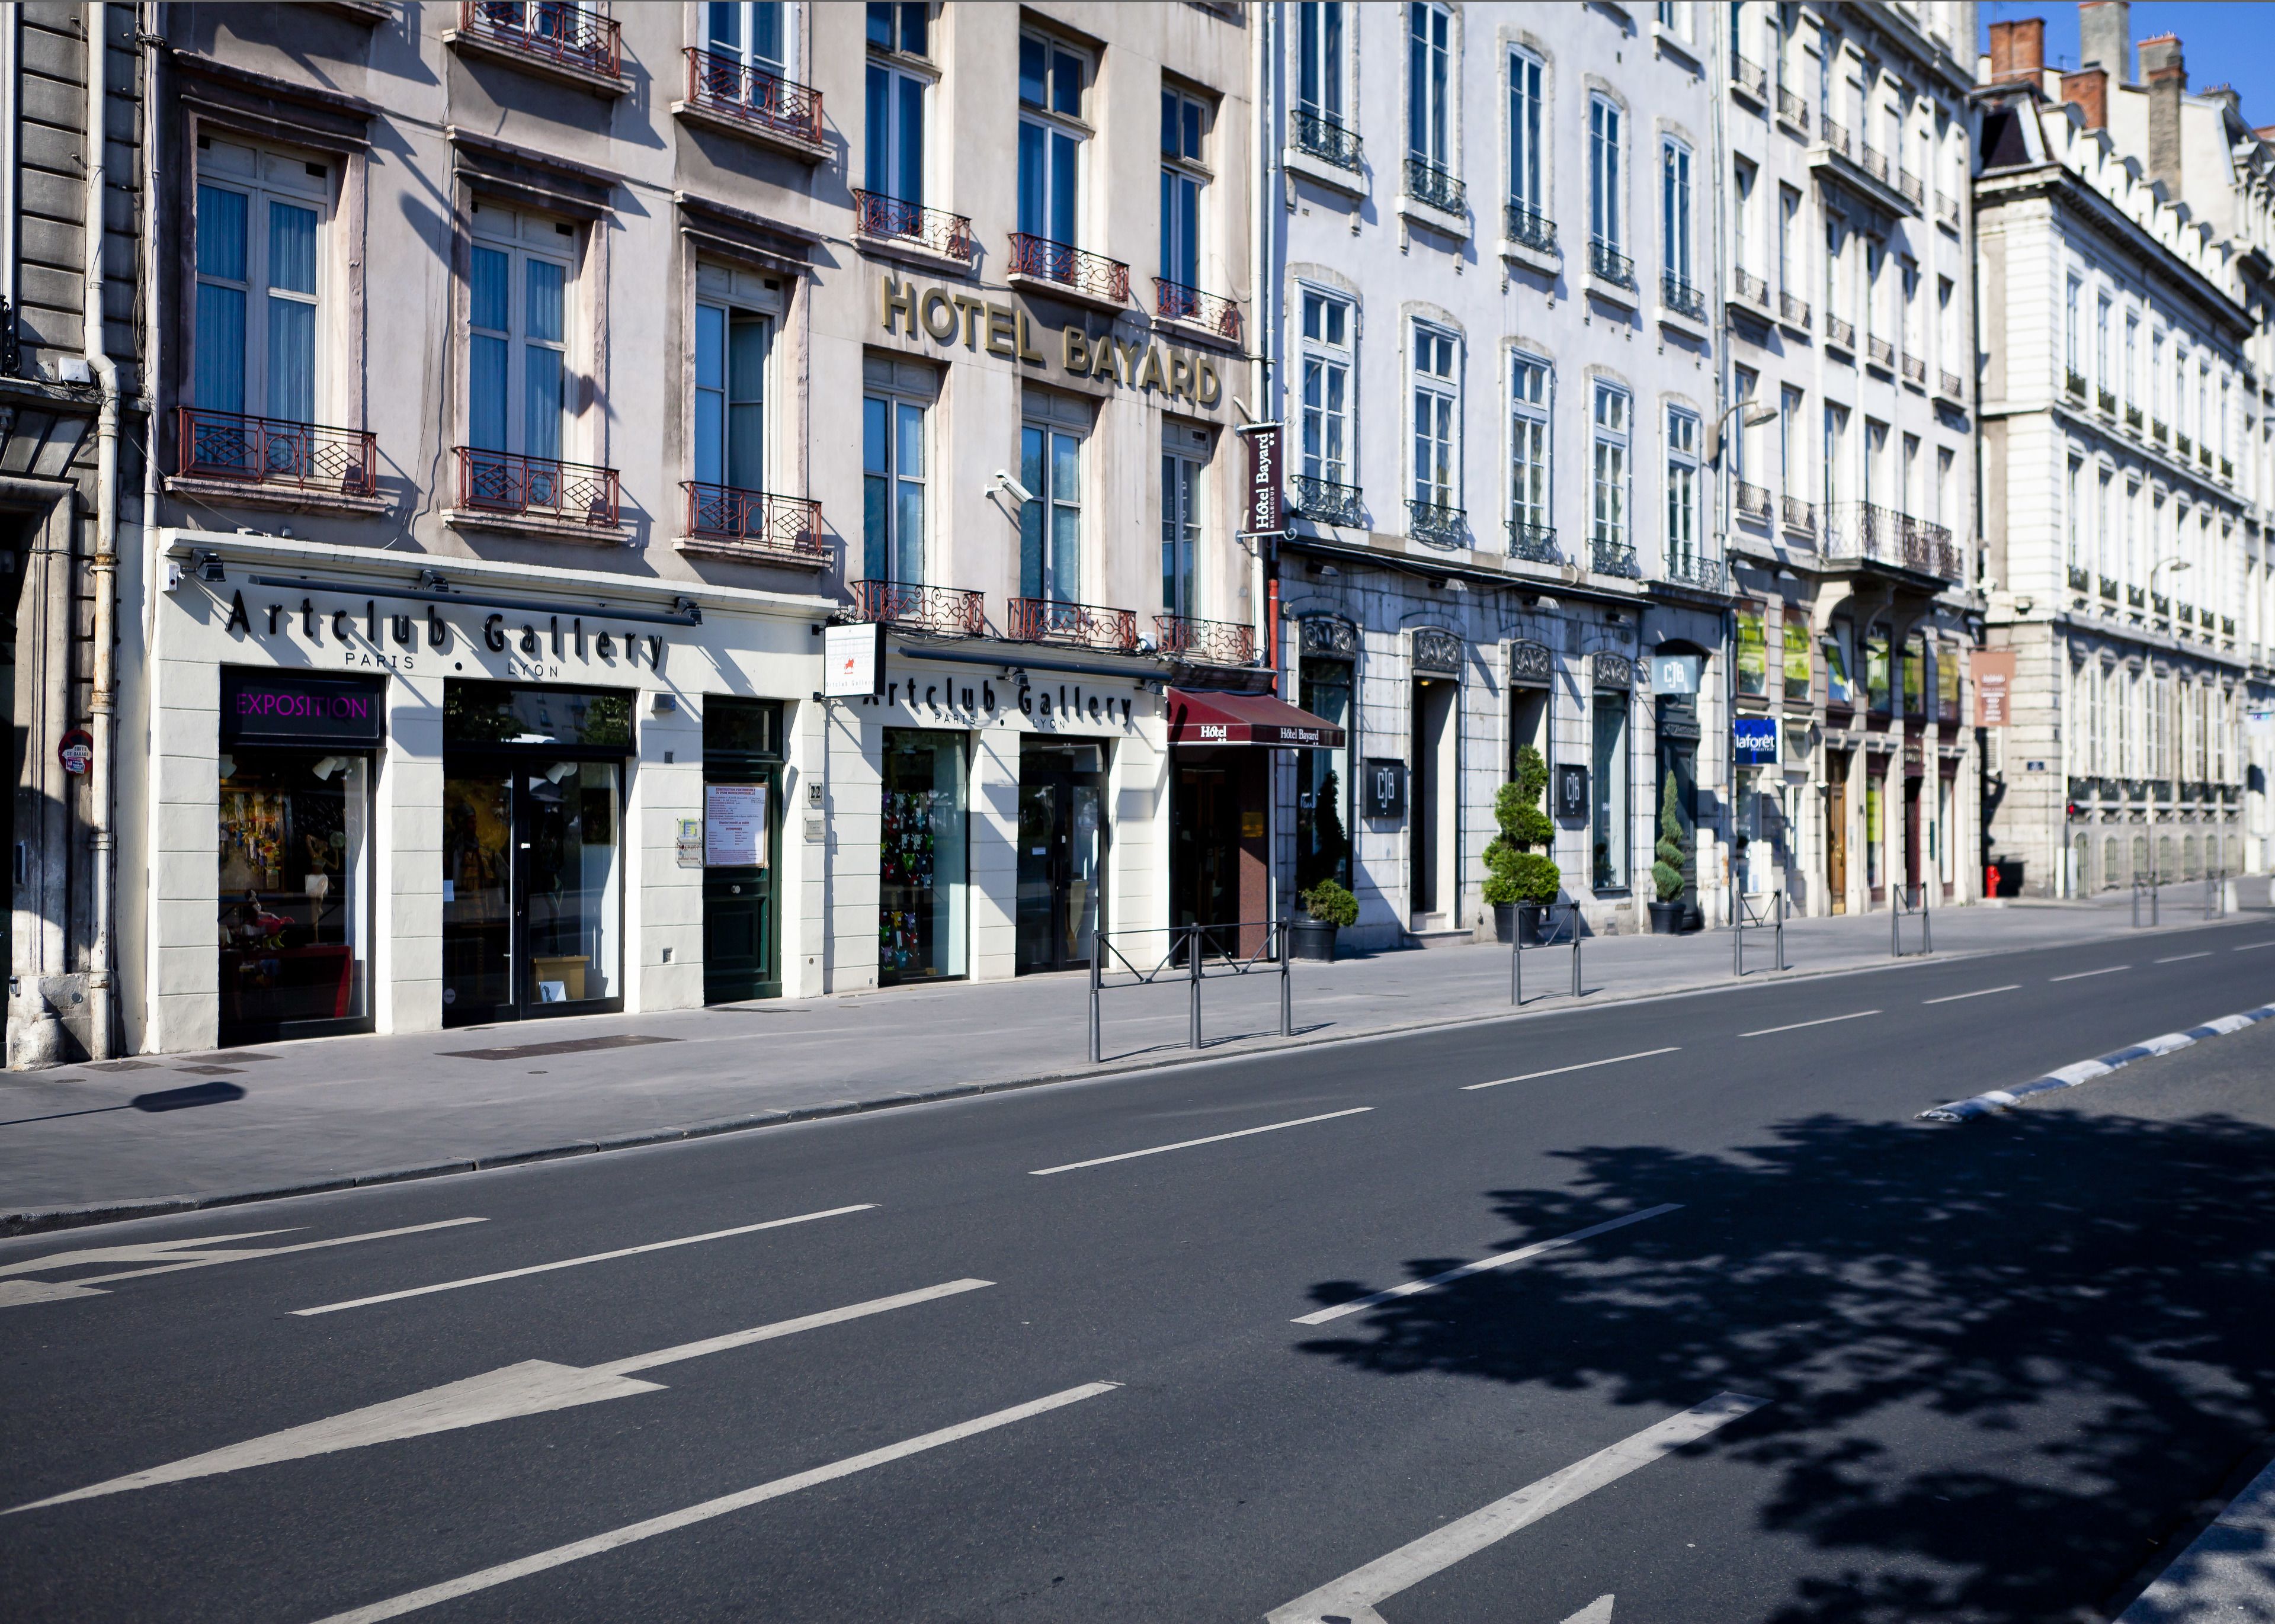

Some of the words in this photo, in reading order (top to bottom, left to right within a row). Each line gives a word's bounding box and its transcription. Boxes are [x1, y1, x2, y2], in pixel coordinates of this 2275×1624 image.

[882, 275, 1043, 362] HOTEL
[1063, 325, 1222, 403] BAYARD
[1255, 432, 1271, 484] Bayard
[1255, 487, 1269, 529] Hôtel
[226, 590, 446, 647] Artclub
[484, 613, 663, 670] Gallery
[346, 652, 415, 670] PARIS
[508, 662, 558, 678] LYON
[236, 694, 367, 719] EXPOSITION
[1018, 685, 1132, 727] Gallery
[935, 714, 976, 725] PARIS
[1033, 718, 1065, 729] LYON
[1200, 725, 1227, 737] Hôtel
[1280, 728, 1297, 739] Hôtel
[1298, 728, 1319, 743] Bayard
[1736, 733, 1775, 749] laforêt
[810, 785, 821, 799] 22
